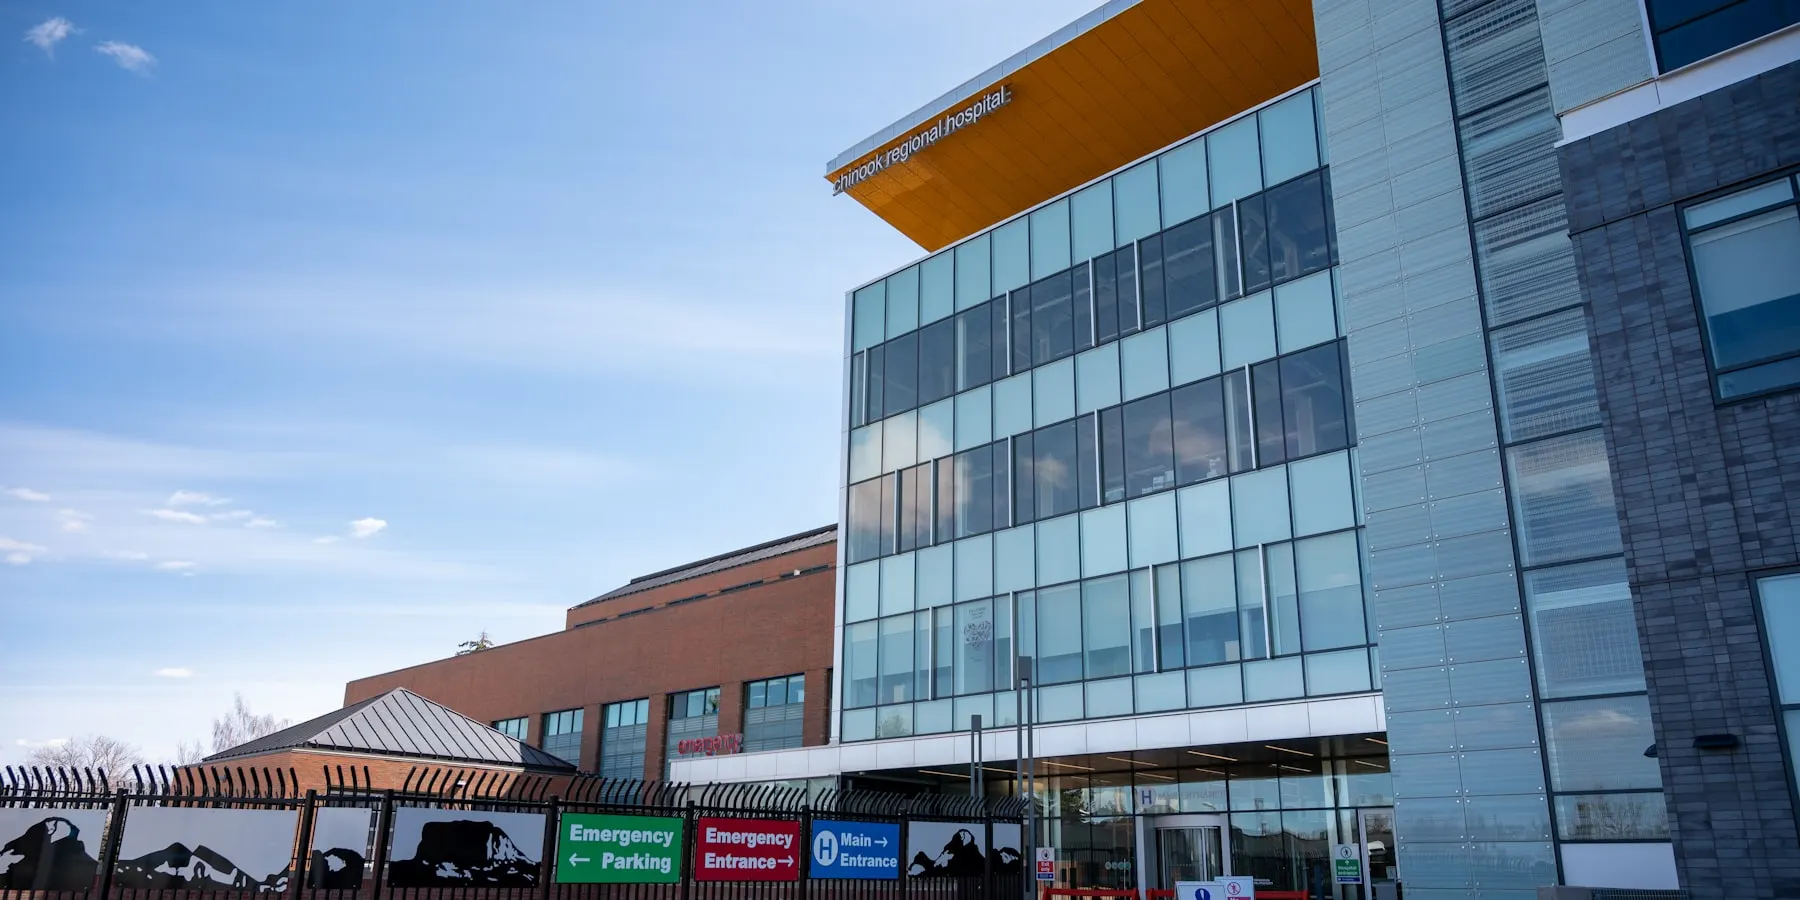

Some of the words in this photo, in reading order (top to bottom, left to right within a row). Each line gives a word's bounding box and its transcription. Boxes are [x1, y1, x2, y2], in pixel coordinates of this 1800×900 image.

[832, 153, 883, 194] chinook
[886, 120, 942, 163] regional
[945, 85, 1004, 134] hospital
[678, 733, 743, 756] emergency
[1141, 789, 1152, 805] H
[570, 823, 674, 848] Emergency
[705, 827, 793, 848] Emergency
[841, 832, 871, 847] Main
[819, 838, 833, 860] H
[602, 852, 672, 874] Parking
[704, 852, 777, 869] Entrance
[840, 853, 898, 868] Entrance
